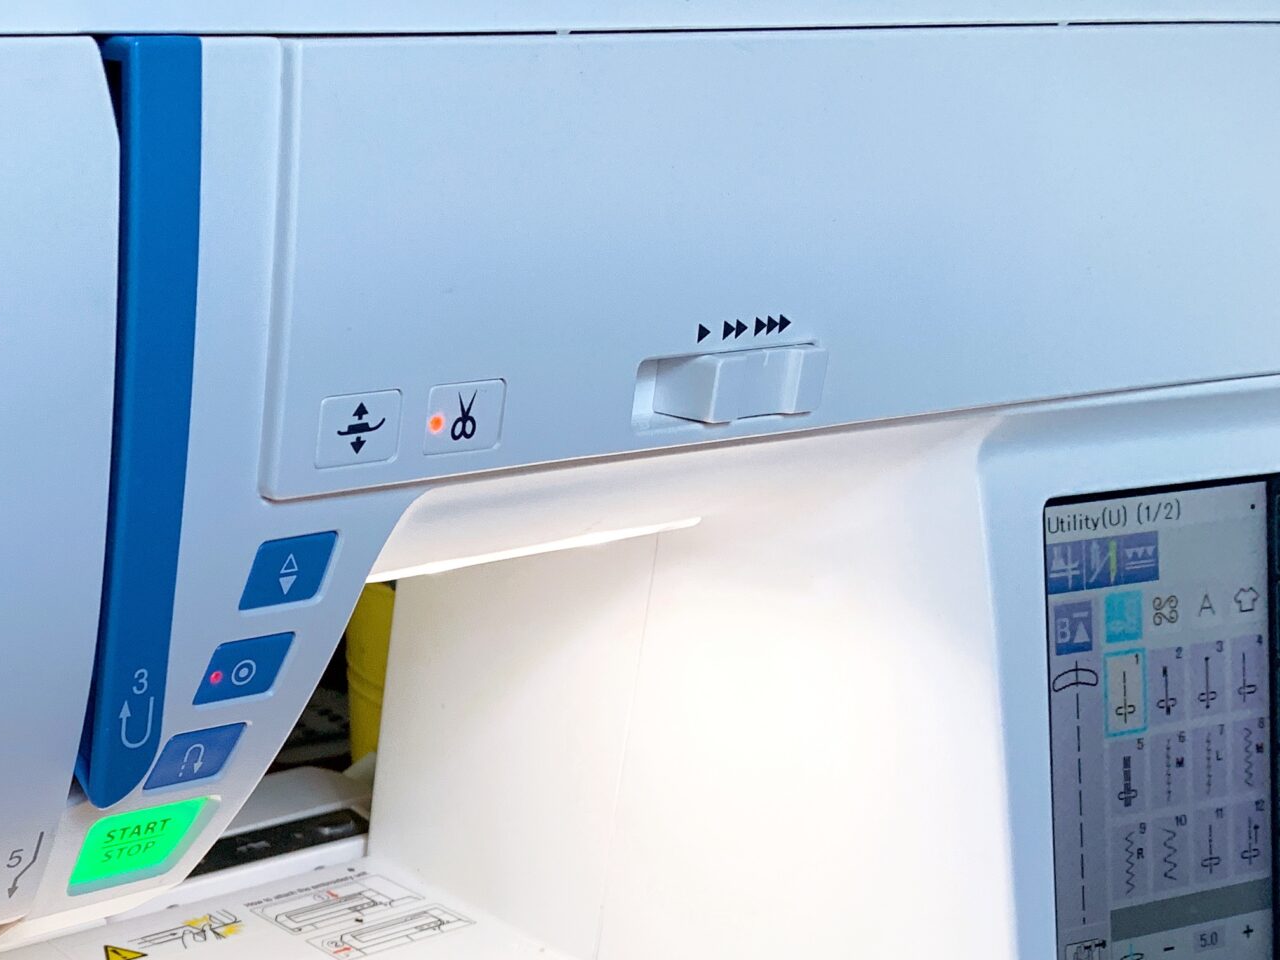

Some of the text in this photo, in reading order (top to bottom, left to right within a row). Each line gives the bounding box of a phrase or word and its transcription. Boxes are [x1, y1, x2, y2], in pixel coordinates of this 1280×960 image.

[1047, 498, 1181, 534] Utility(U) (1/2)
[1175, 646, 1183, 659] 2
[1216, 640, 1224, 653] 3
[132, 668, 148, 694] 3
[106, 817, 172, 844] START
[1175, 814, 1187, 826] 10
[6, 848, 24, 868] 5
[102, 840, 156, 863] STOP
[1200, 931, 1218, 948] 5.0
